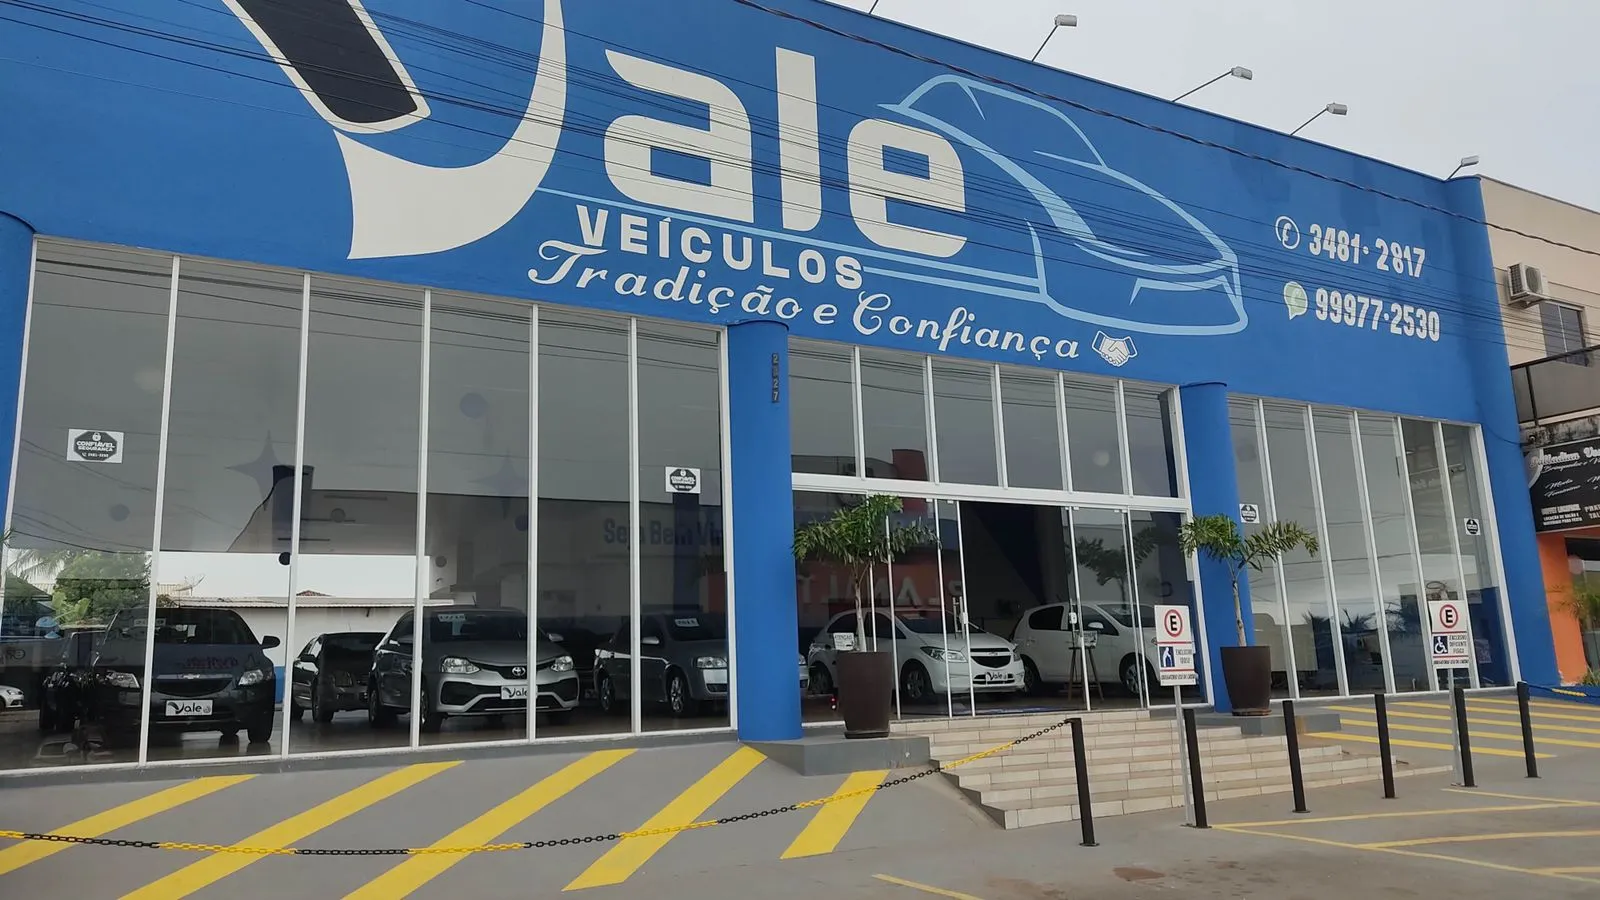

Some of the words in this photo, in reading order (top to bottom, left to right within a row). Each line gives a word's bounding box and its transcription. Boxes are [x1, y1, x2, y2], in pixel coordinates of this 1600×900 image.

[576, 204, 863, 290] VEÍCULOS
[527, 240, 802, 314] Tradição
[813, 303, 838, 324] e
[852, 290, 1079, 360] Confiança
[1169, 615, 1178, 631] E
[1445, 609, 1454, 623] E
